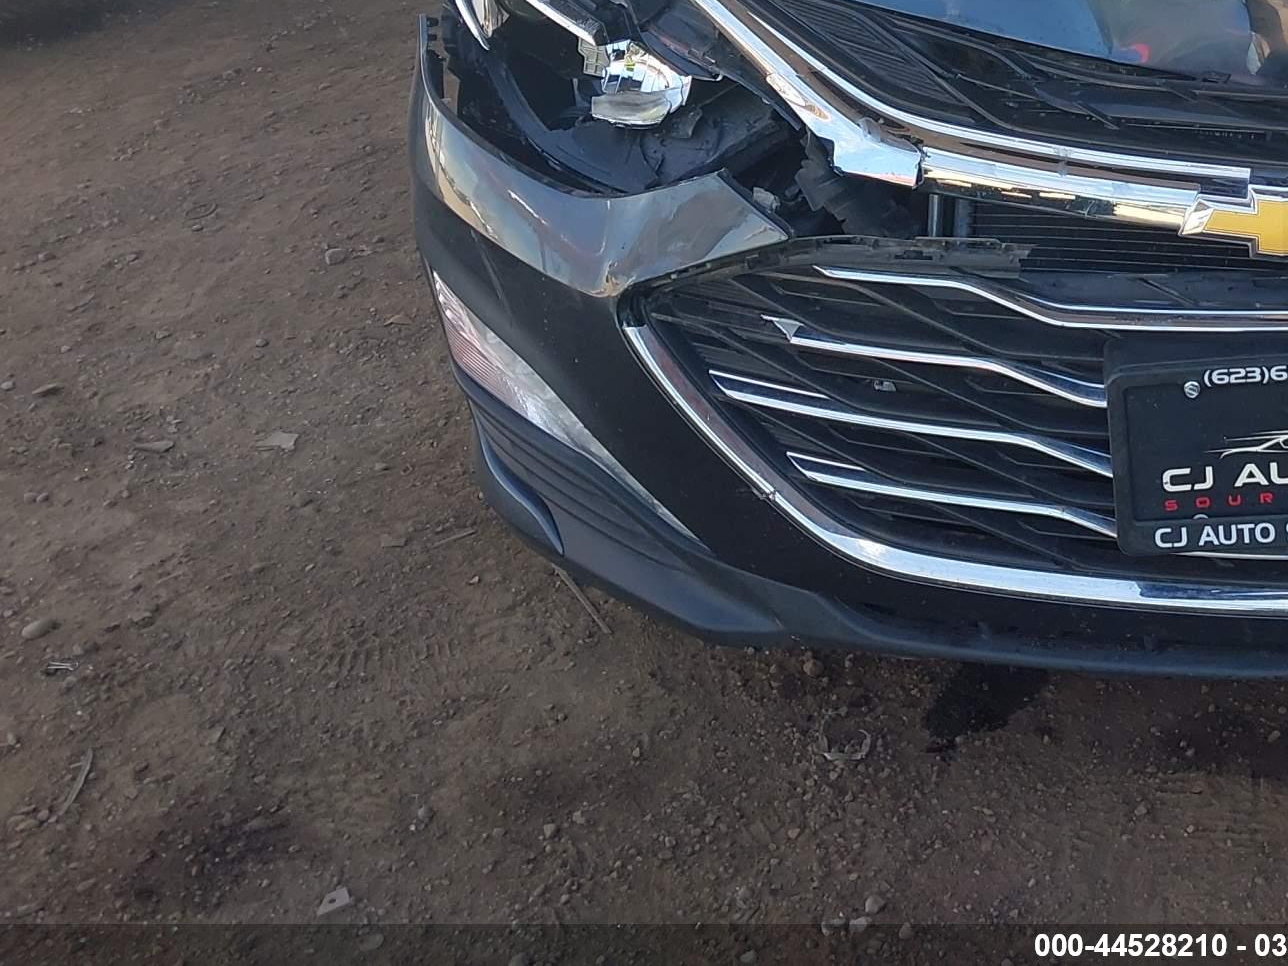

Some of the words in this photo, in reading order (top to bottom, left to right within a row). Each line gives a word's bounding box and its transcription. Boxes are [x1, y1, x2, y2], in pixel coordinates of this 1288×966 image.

[1162, 467, 1214, 492] CJ
[1155, 525, 1188, 548] CJ
[1198, 520, 1276, 546] AUTO
